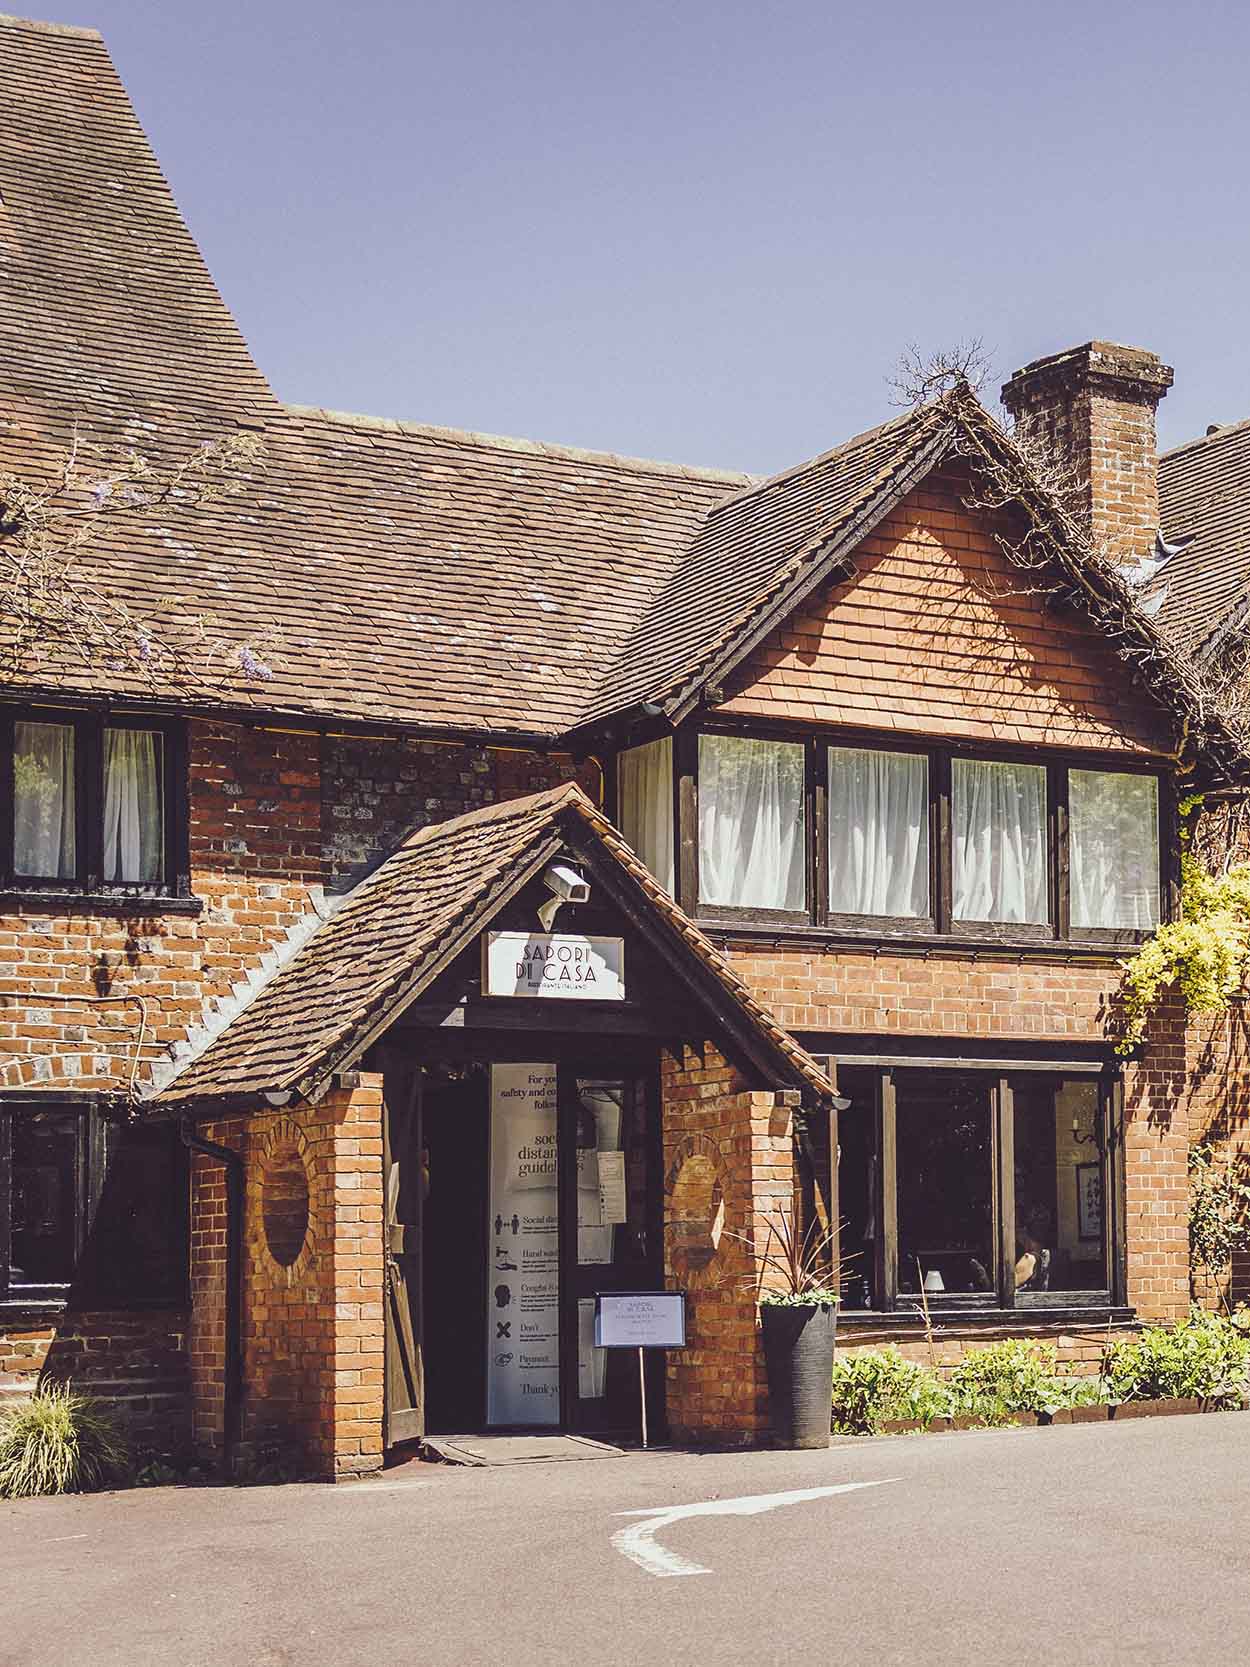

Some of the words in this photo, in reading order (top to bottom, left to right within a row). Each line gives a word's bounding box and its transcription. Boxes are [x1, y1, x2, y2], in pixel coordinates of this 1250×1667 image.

[523, 944, 589, 962] SAPORI
[516, 962, 533, 980] DI
[542, 963, 597, 982] CASA
[535, 1135, 556, 1145] soc
